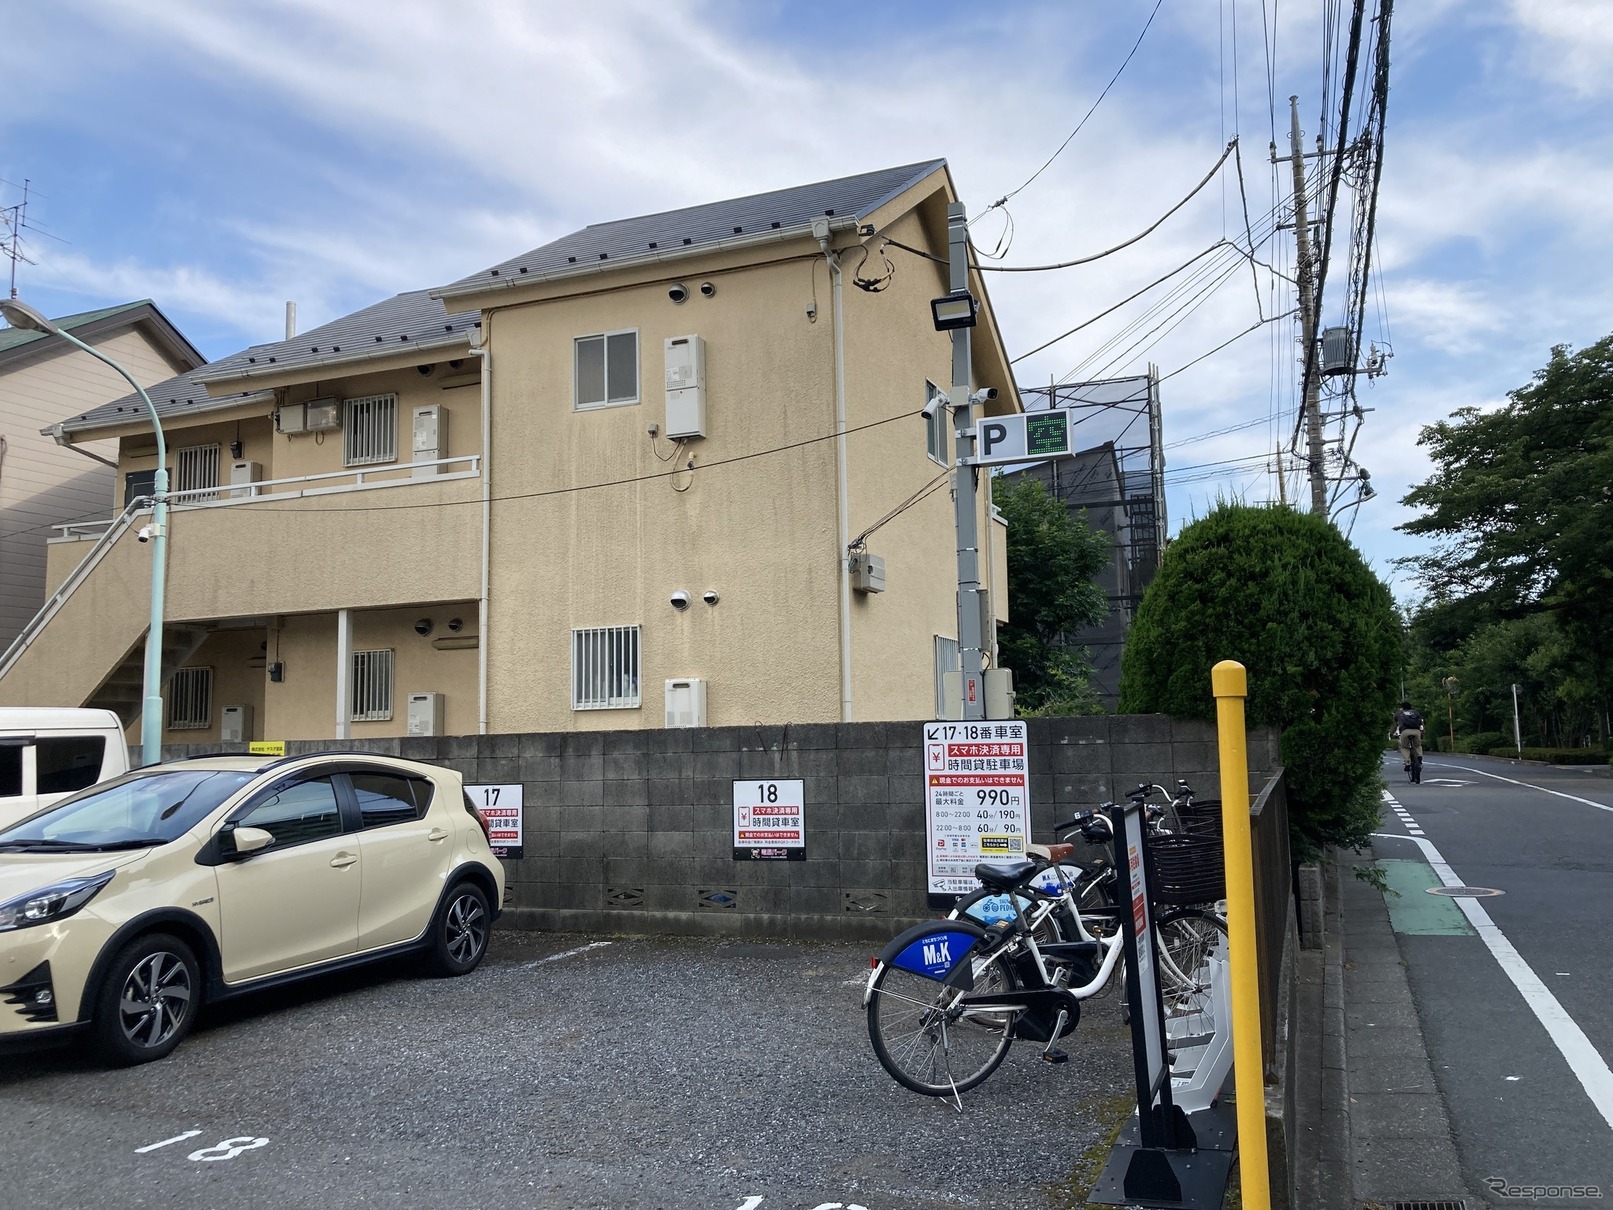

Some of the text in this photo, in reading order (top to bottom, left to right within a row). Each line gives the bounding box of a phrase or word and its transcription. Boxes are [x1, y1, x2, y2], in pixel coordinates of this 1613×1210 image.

[983, 423, 1007, 456] P
[1028, 415, 1067, 454] 空
[950, 744, 1021, 755] スマホ決済専用
[948, 758, 1024, 771] 時間貸駐車場
[939, 776, 1023, 785] 現金でのお支払いはできません
[484, 788, 501, 807] 17
[758, 783, 778, 803] 18
[976, 789, 1020, 806] 990円
[935, 798, 964, 806] 最大料金
[754, 807, 798, 815] スマホ決済専用
[753, 817, 800, 828] 時間貸車室
[923, 942, 951, 965] M&K
[134, 1130, 270, 1162] 18
